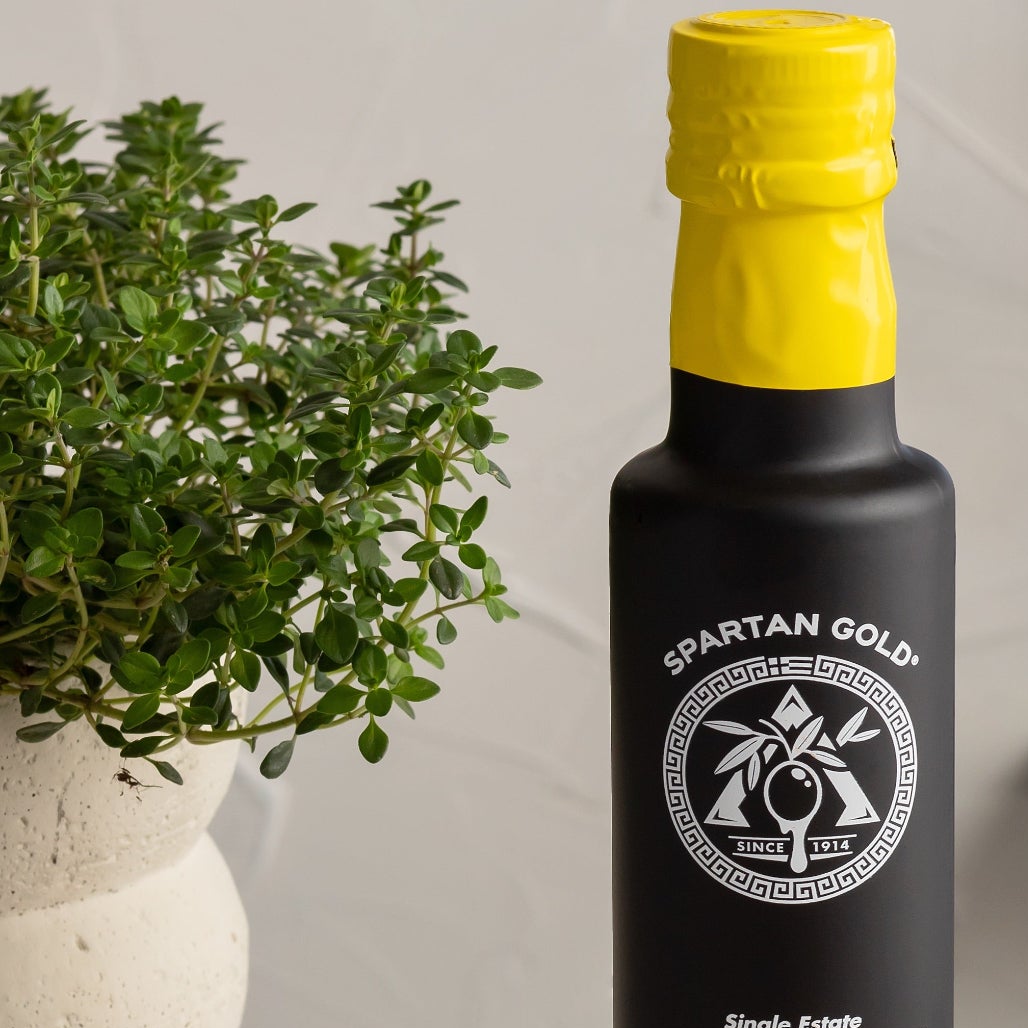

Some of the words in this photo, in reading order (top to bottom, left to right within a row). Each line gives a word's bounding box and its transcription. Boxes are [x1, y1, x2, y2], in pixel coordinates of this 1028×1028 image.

[663, 612, 820, 675] SPARTAN
[736, 840, 784, 853] SINCE
[812, 840, 850, 852] 1914
